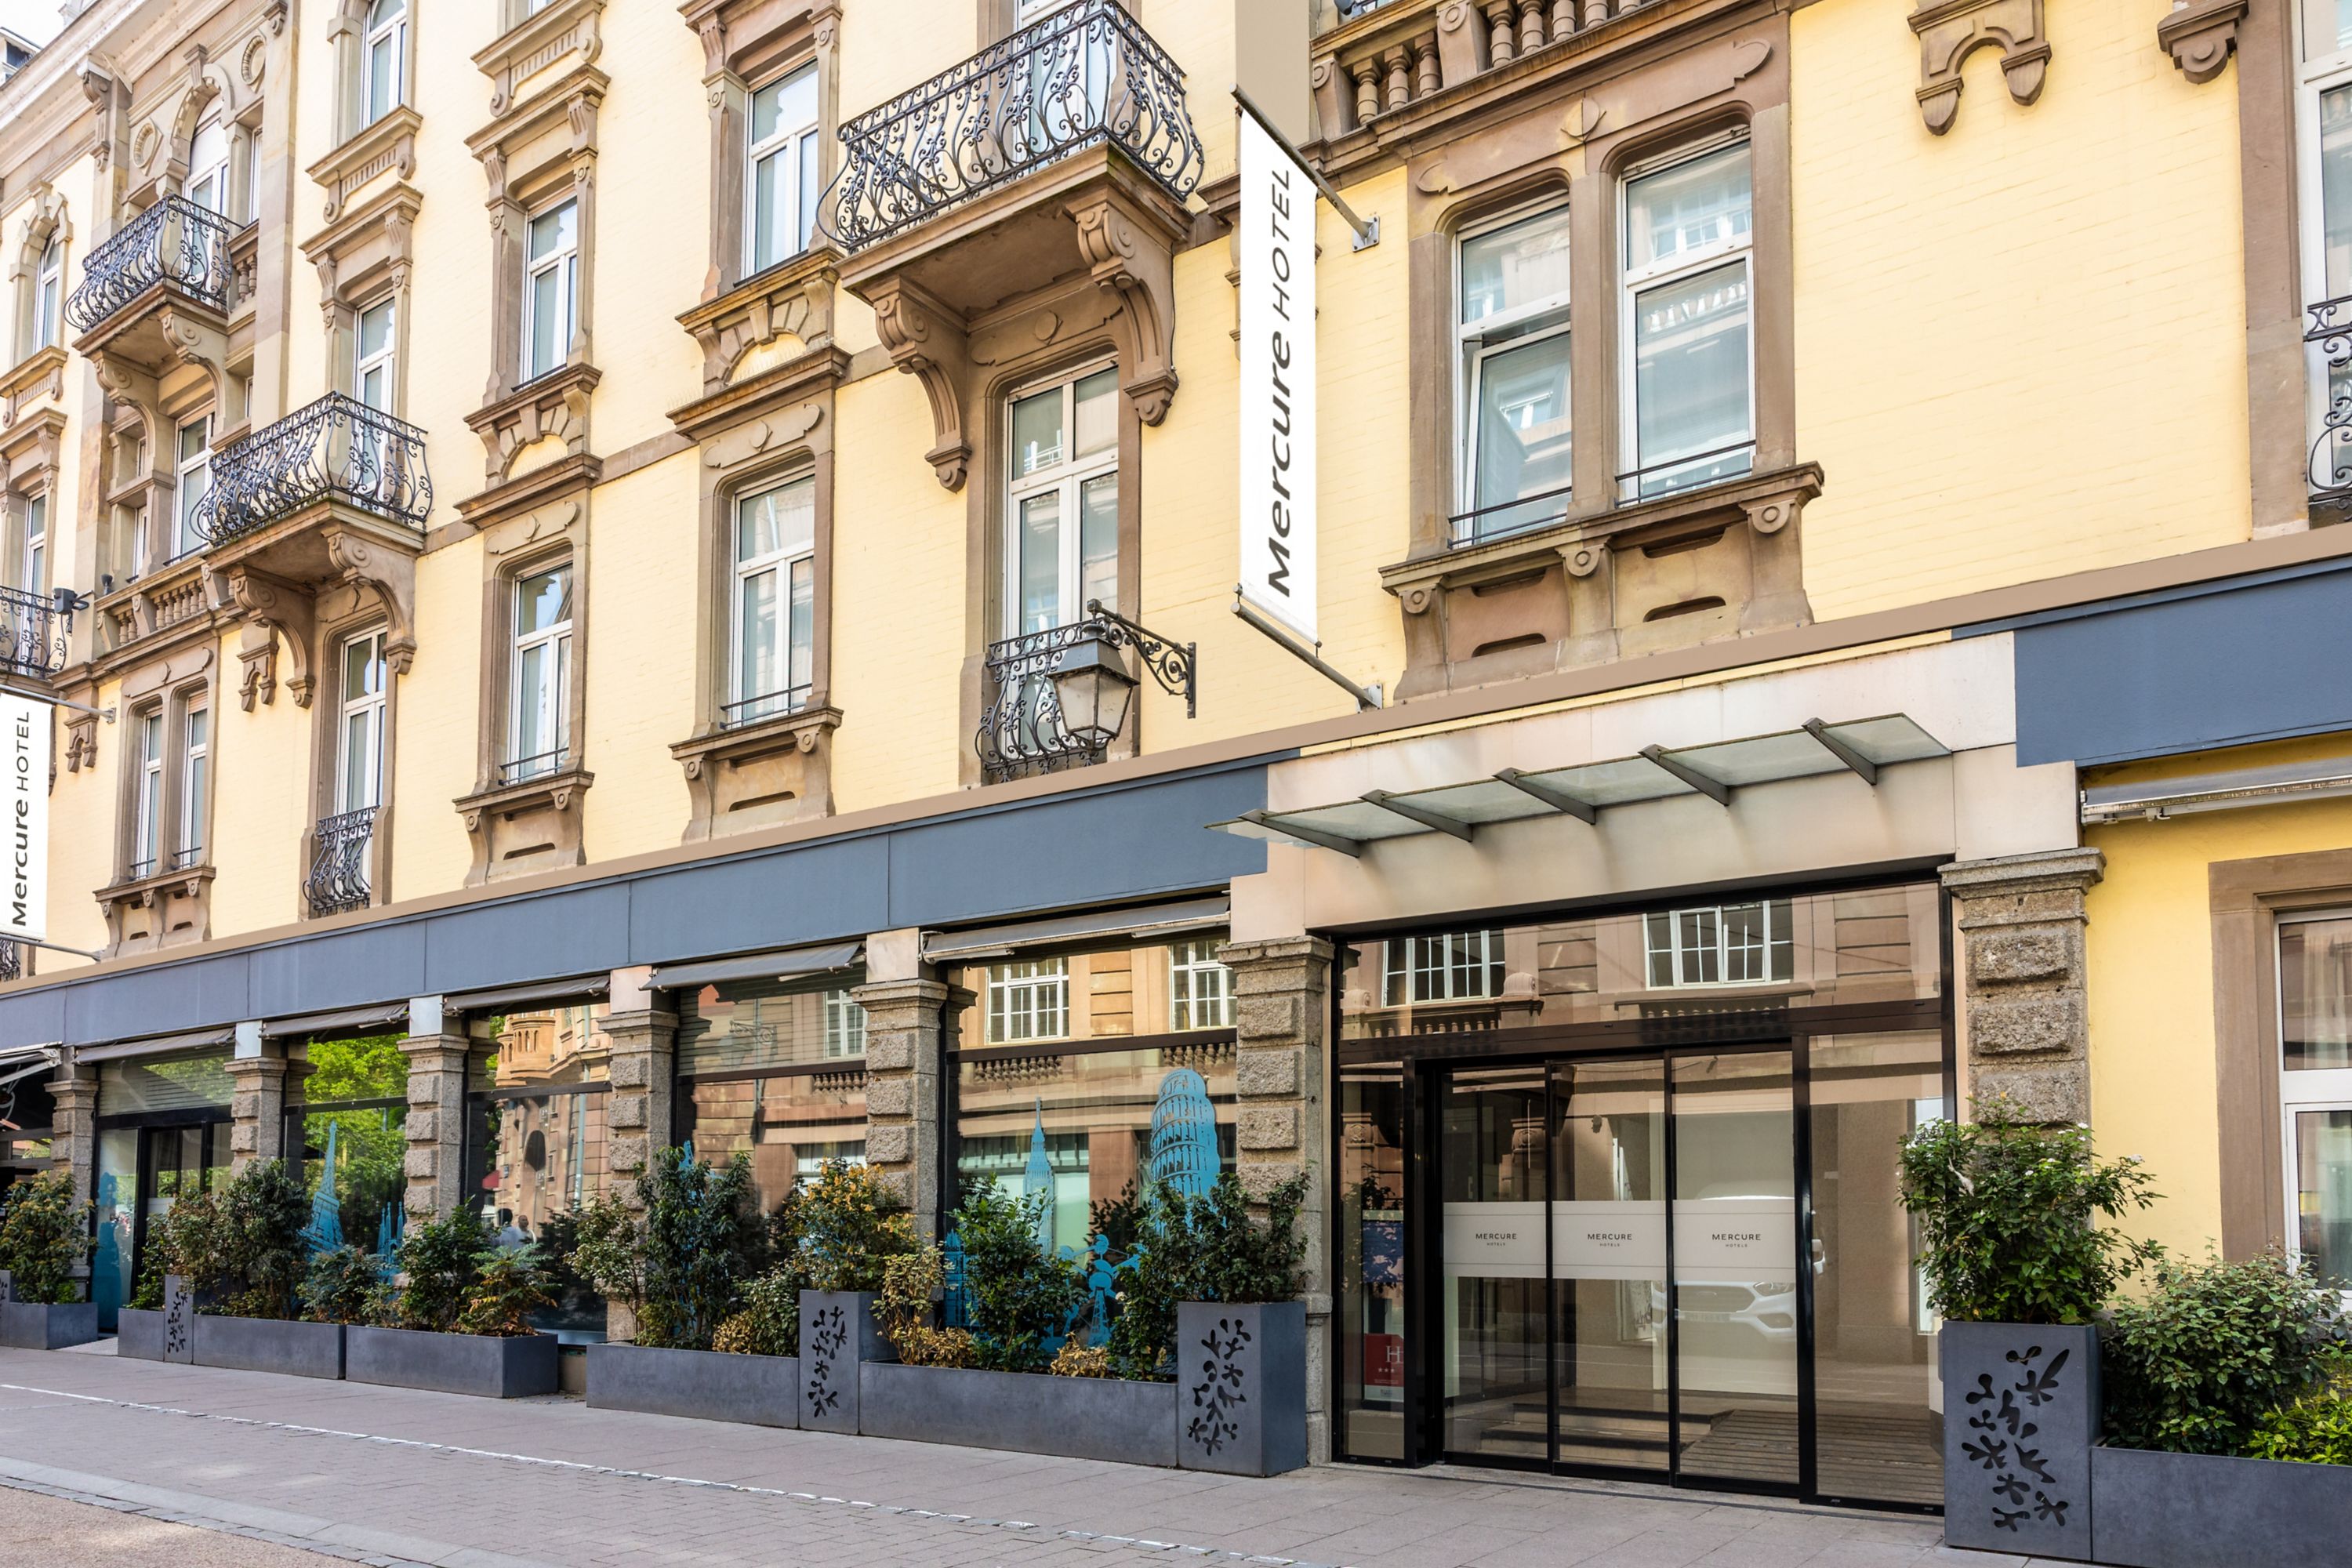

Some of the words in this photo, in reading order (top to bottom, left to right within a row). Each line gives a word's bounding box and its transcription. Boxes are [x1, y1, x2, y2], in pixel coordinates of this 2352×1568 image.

[1270, 169, 1290, 322] HOTEL
[1268, 331, 1291, 598] Mercure
[16, 711, 30, 792] HOTEL
[12, 798, 29, 927] Mercure
[1386, 1345, 1403, 1364] H
